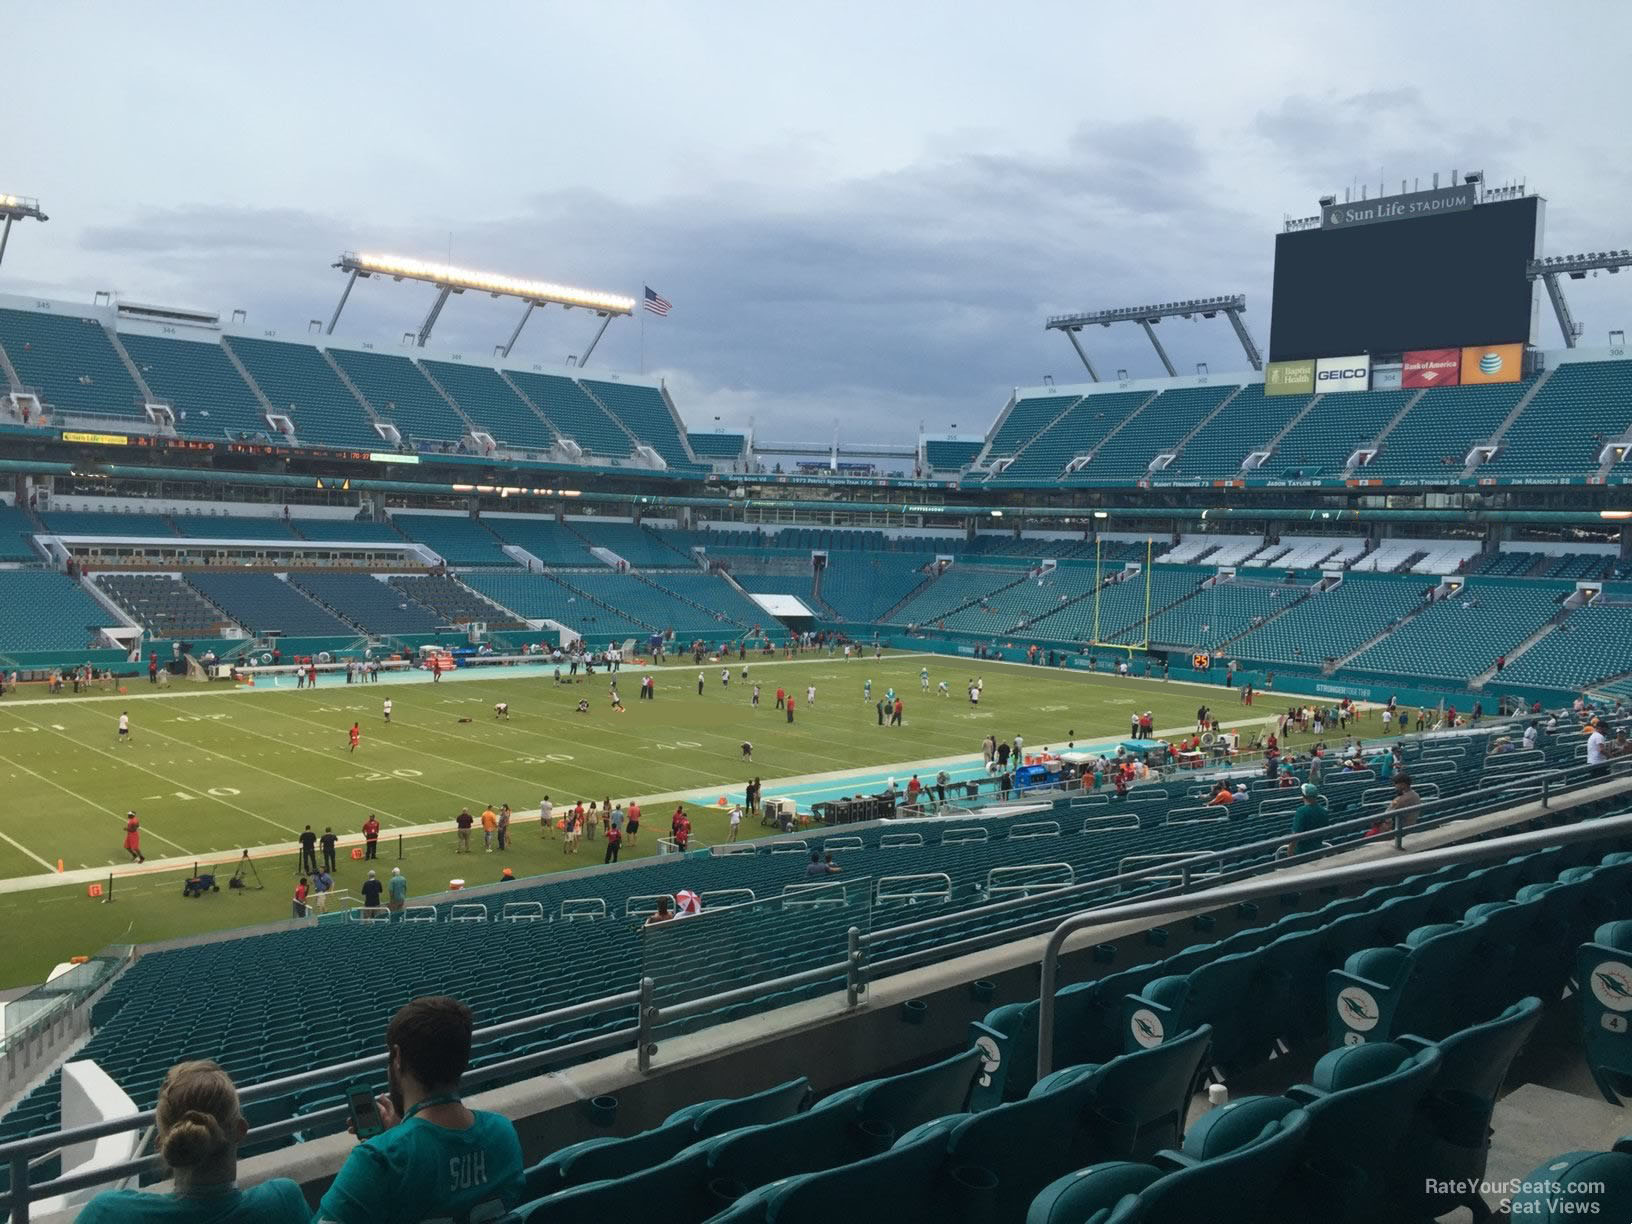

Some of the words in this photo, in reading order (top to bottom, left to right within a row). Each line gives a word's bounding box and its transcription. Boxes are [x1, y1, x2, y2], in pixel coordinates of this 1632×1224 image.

[1345, 208, 1374, 223] Sun
[1377, 201, 1405, 218] Life
[1409, 196, 1466, 213] STADIUM
[1284, 367, 1311, 376] Baptist
[1404, 363, 1421, 371] Bank
[1421, 361, 1428, 369] of
[1428, 360, 1457, 369] America
[1284, 376, 1309, 384] Health
[1318, 368, 1367, 381] GEICO
[1194, 655, 1207, 668] 25
[1609, 1017, 1618, 1029] 4
[1351, 1035, 1359, 1045] 3
[449, 1150, 488, 1192] SUH
